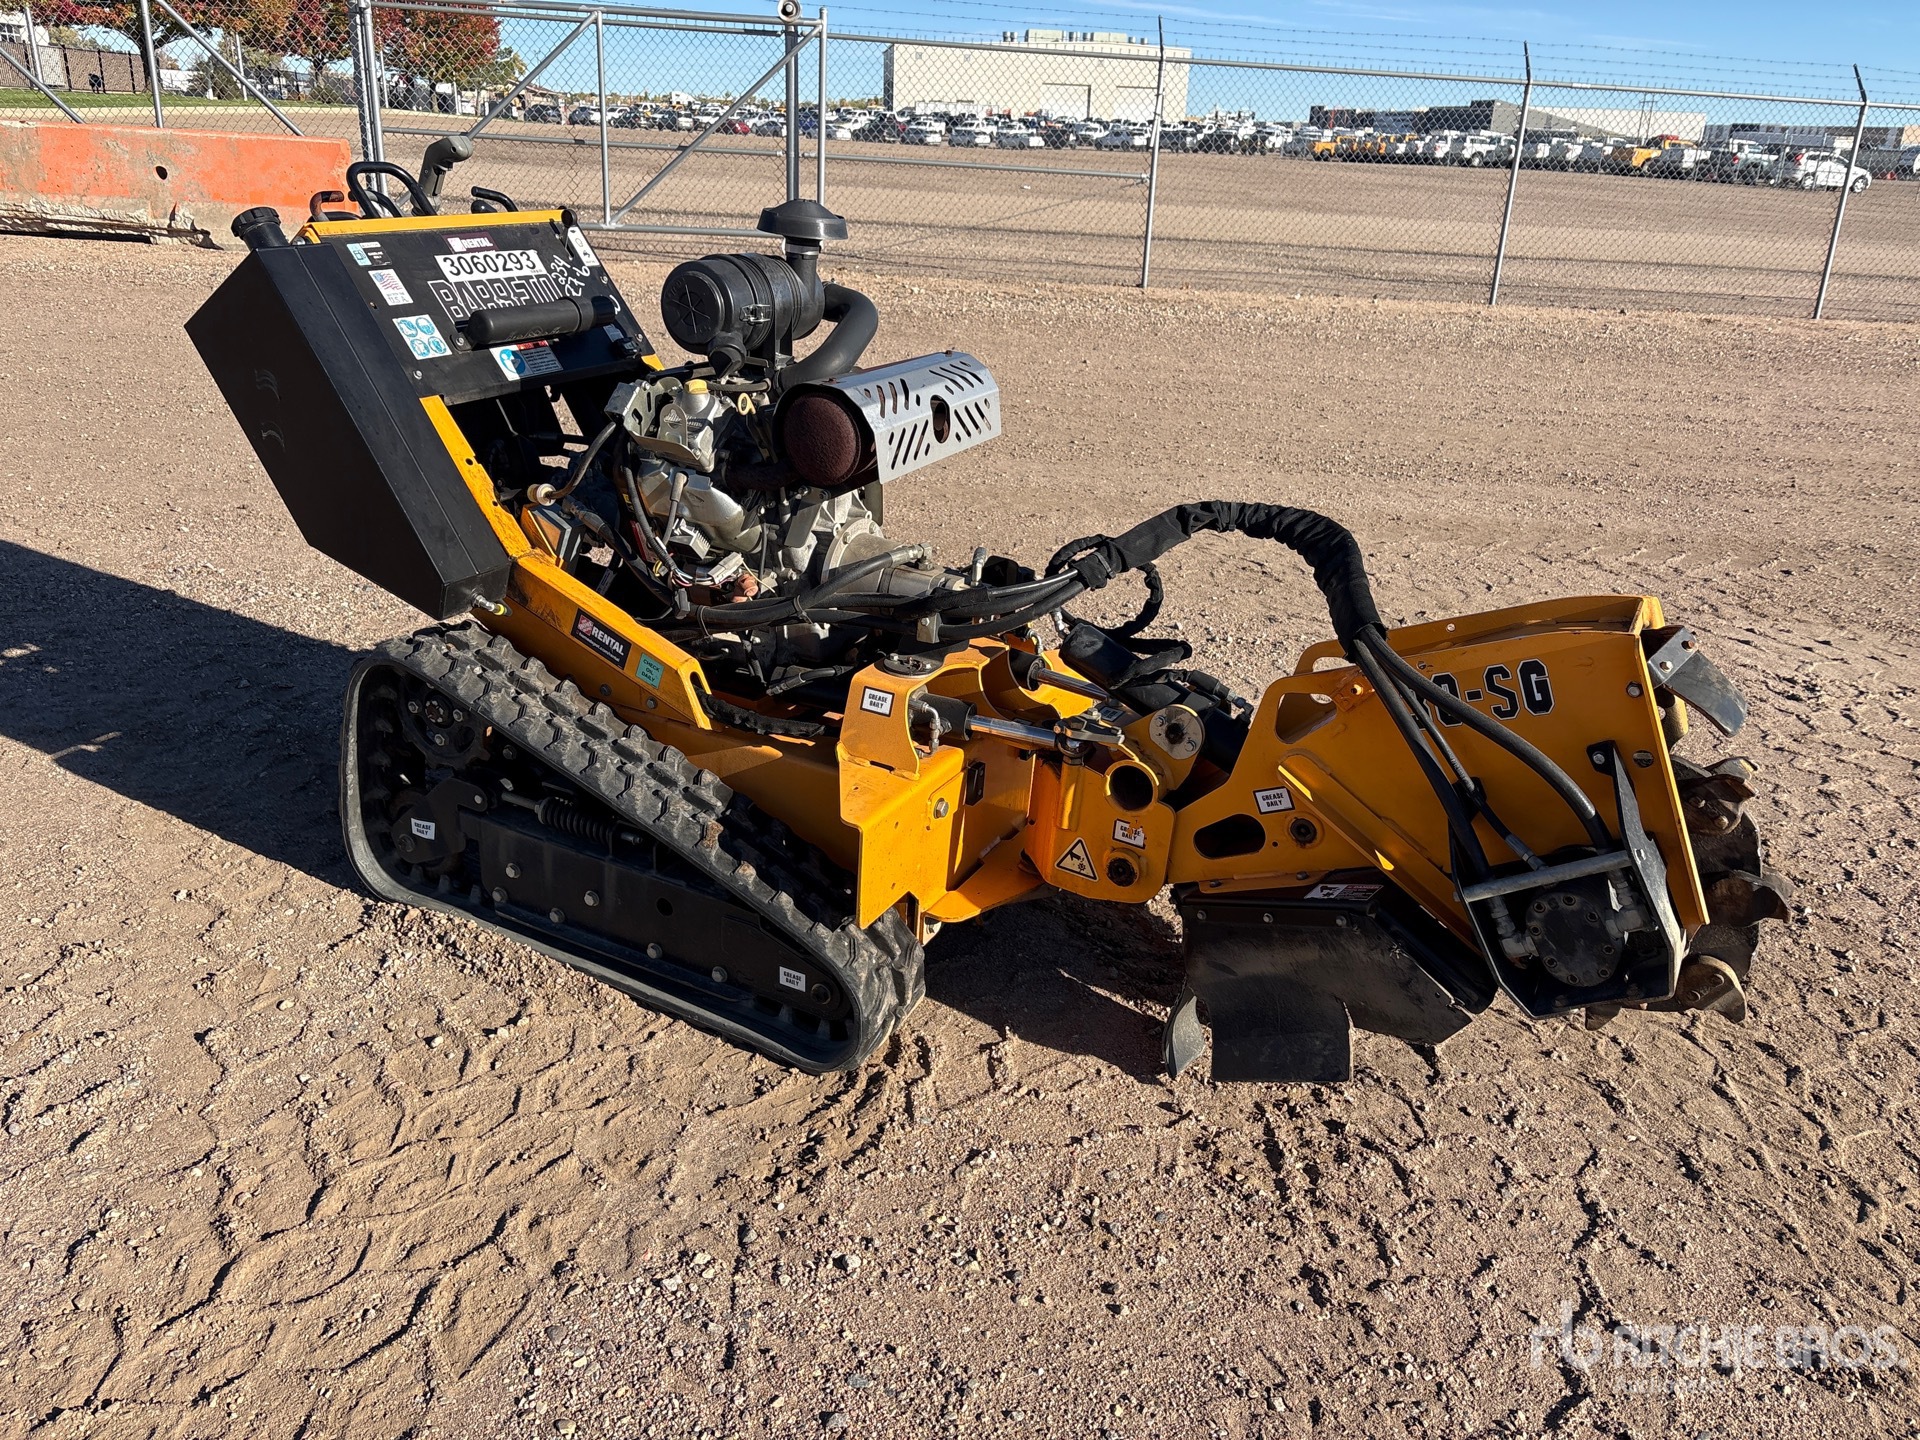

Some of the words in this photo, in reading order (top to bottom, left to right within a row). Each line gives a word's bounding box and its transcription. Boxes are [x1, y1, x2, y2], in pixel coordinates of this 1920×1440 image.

[461, 237, 494, 249] RENTAL
[443, 251, 537, 276] 3060293
[550, 254, 572, 286] 234
[591, 625, 625, 657] RENTAL
[642, 658, 660, 673] CHECK
[645, 667, 654, 676] OIL
[641, 671, 656, 683] DAILY
[868, 693, 888, 704] GREASE
[869, 700, 884, 709] DAILY
[1261, 792, 1285, 802] GREASE
[1265, 799, 1283, 808] DAILY
[783, 970, 802, 982] GREASE
[785, 977, 800, 987] DAILY
